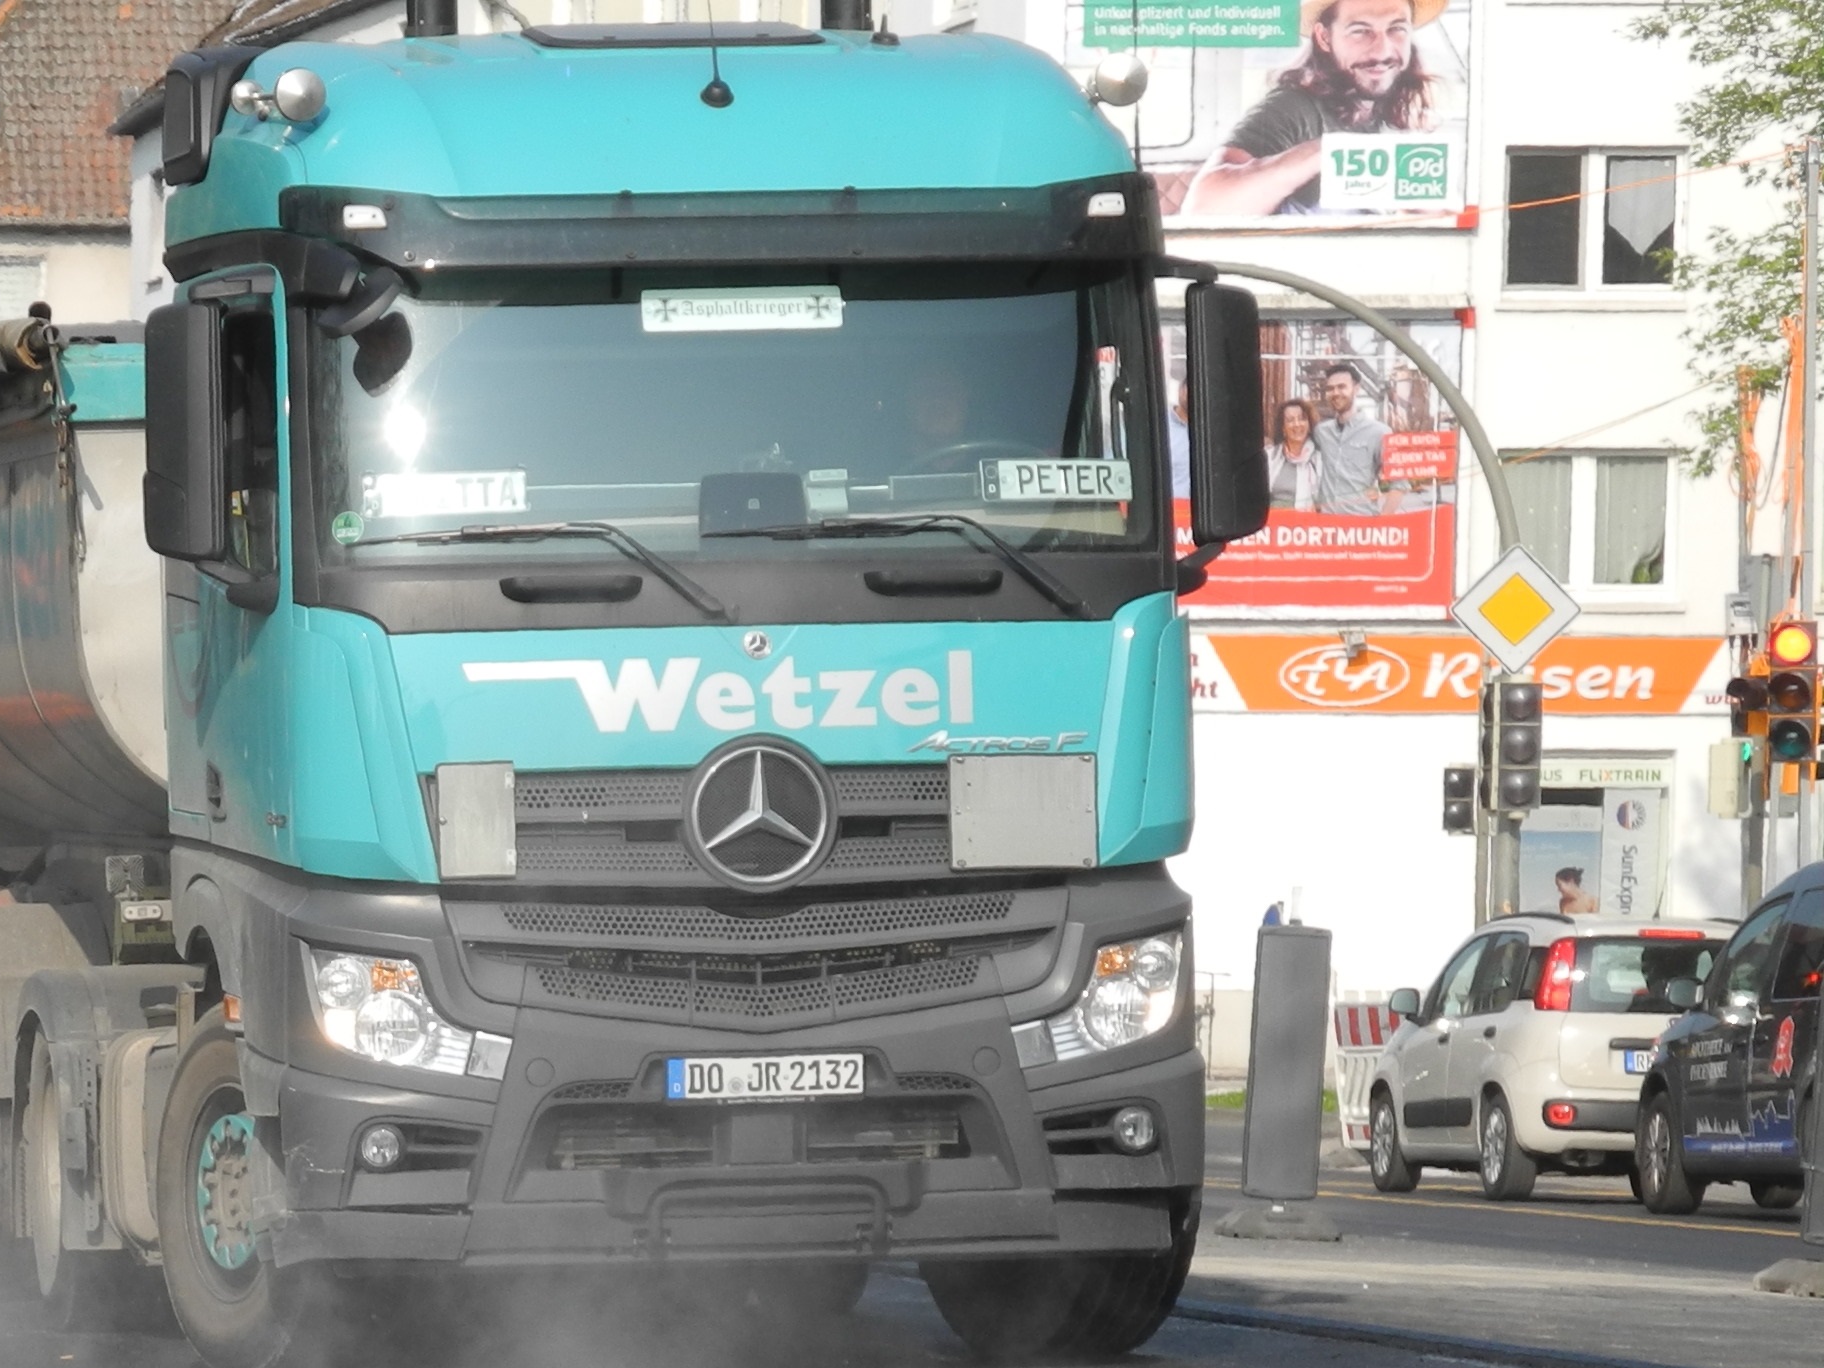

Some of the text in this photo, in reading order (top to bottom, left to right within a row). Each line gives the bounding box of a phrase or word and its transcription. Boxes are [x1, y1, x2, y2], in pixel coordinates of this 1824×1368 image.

[1187, 6, 1211, 19] und
[1094, 22, 1107, 36] in
[1189, 22, 1227, 36] Fonds
[1231, 23, 1285, 39] anlegen.
[1331, 149, 1389, 177] 150
[1397, 179, 1445, 196] Bank
[1016, 464, 1115, 495] PETER
[1277, 526, 1409, 546] DORTMUND!
[1423, 652, 1655, 700] Rsen
[462, 650, 973, 732] Wetzel
[688, 1059, 860, 1094] DO JR 2132
